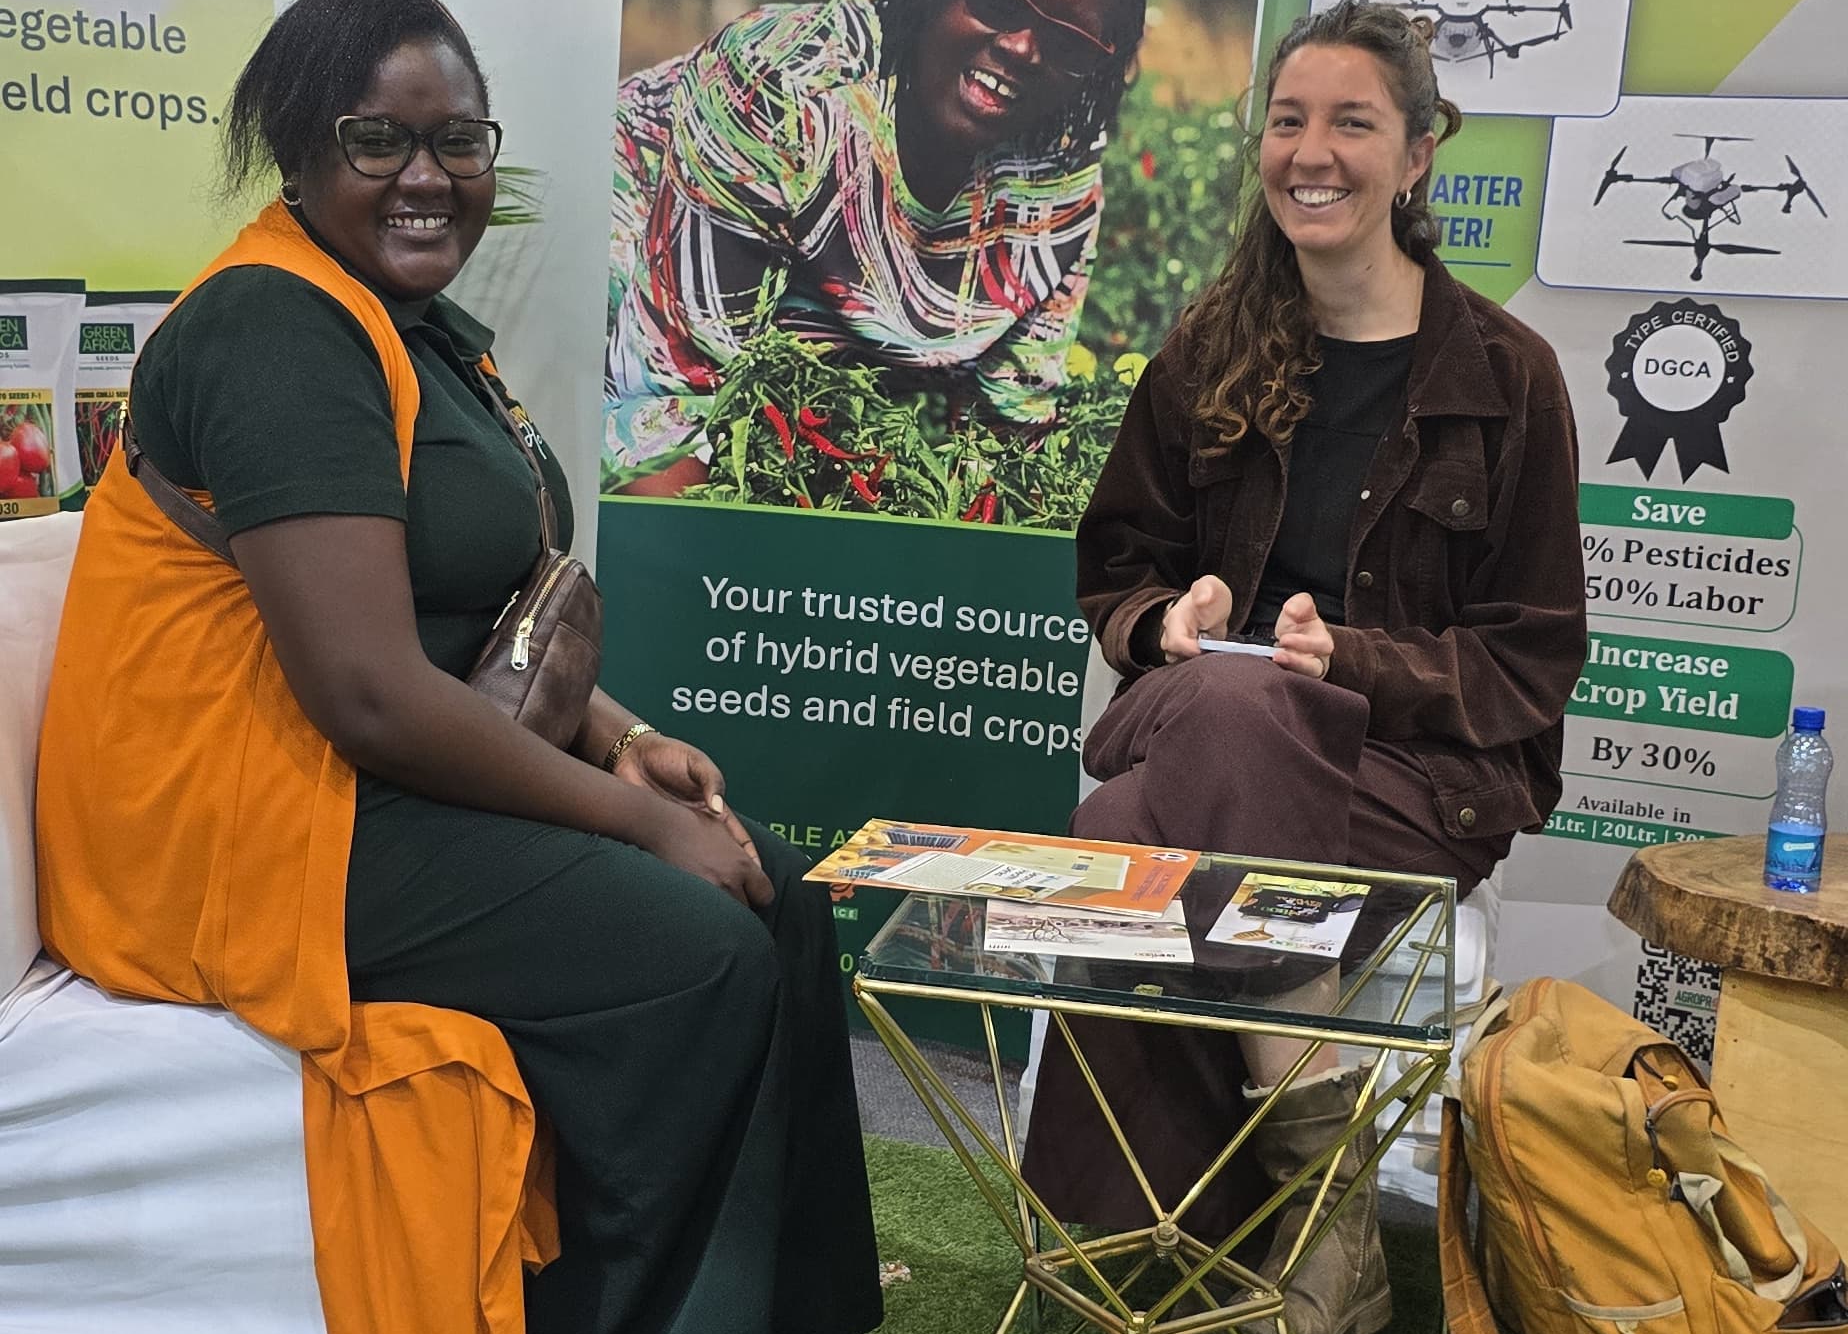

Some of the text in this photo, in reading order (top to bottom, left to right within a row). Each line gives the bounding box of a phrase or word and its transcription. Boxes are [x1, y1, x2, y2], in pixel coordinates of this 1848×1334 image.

[86, 88, 220, 130] crops.
[82, 326, 127, 339] GREEN
[82, 338, 132, 352] AFRICA
[1625, 310, 1740, 363] TYPE CERTIFIED
[1644, 358, 1711, 378] DGCA
[1631, 495, 1706, 525] Save
[1622, 539, 1790, 577] Pesticides
[702, 576, 1089, 644] Your trusted source
[1585, 575, 1764, 615] 50% Labor
[706, 631, 1079, 697] of hybrid vegetable
[1588, 638, 1729, 677] Increase
[671, 684, 790, 719] seeds
[802, 695, 876, 726] and
[887, 698, 972, 738] field
[1570, 677, 1739, 720] Crop Yield
[1591, 736, 1716, 777] By 30%
[1577, 794, 1691, 824] Available in
[1601, 822, 1657, 844] 20Ltr.
